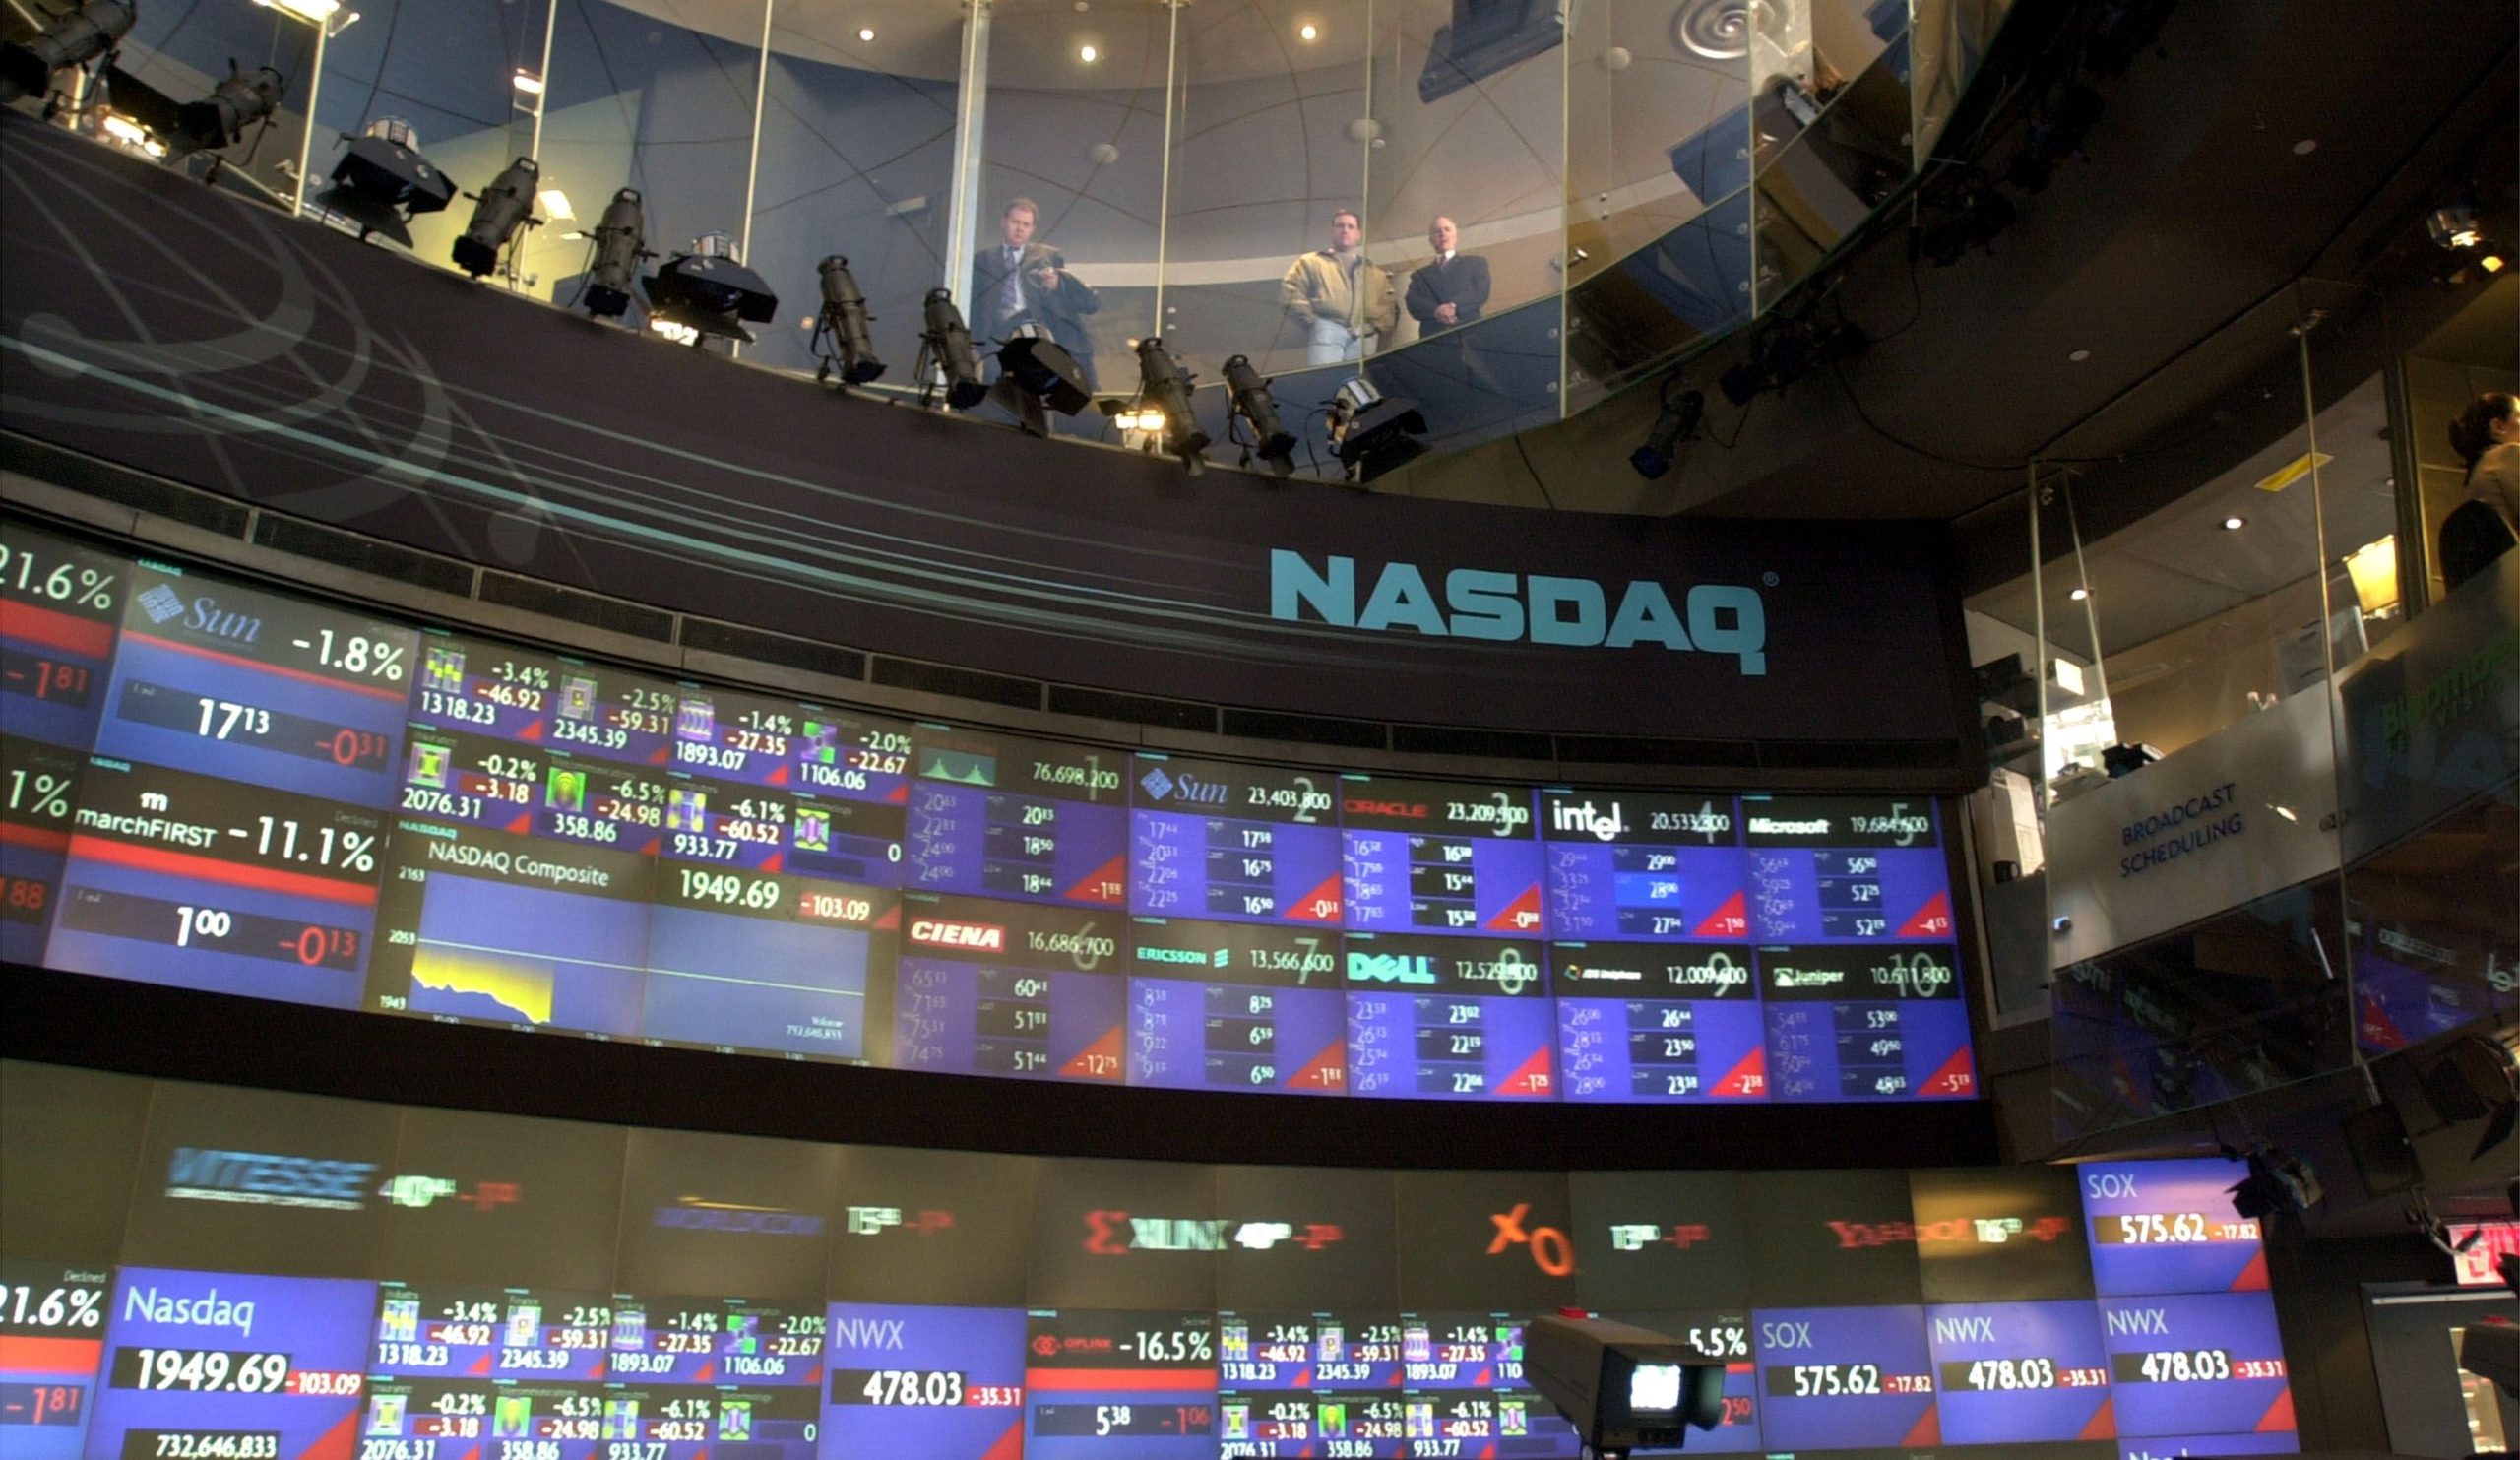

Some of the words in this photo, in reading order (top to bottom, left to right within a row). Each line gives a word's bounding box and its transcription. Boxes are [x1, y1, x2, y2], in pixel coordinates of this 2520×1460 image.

[1271, 548, 1767, 676] NASDAQ
[183, 596, 261, 643] Sun
[293, 629, 405, 680] -1.8%
[492, 662, 549, 689] -3.4%
[420, 691, 495, 725] 1318.23
[477, 684, 541, 712] -46.92
[622, 688, 676, 714] -2.5%
[609, 709, 670, 735] -59.31
[738, 711, 792, 735] -1.4%
[553, 719, 628, 750] 2345.39
[727, 731, 787, 757] -27.35
[859, 730, 912, 755] -2.0%
[675, 741, 745, 770] 1893.07
[849, 751, 907, 775] -22.67
[477, 754, 537, 782] -0.2%
[800, 762, 867, 791] 1106.06
[475, 778, 530, 804] -3.18
[610, 780, 665, 805] -6.5%
[1174, 772, 1228, 803] Sun
[140, 792, 169, 812] m
[401, 787, 482, 820] 2076.31
[730, 798, 786, 823] -6.1%
[1344, 799, 1427, 818] ORACLE
[598, 799, 662, 828] -24.98
[2122, 783, 2236, 846] BROADCAST
[554, 813, 617, 843] 358.86
[719, 821, 780, 845] -60.52
[1748, 817, 1831, 834] Microsoft
[75, 807, 218, 848] marchFIRST
[227, 815, 375, 872] -11.1%
[673, 834, 738, 860] 933.77
[2120, 813, 2243, 878] SCHEDULING
[428, 841, 511, 874] NASDAQ
[514, 855, 610, 887] Composite
[887, 843, 902, 863] 0
[680, 868, 780, 910] 1949.69
[801, 895, 870, 921] -103.09
[911, 921, 1001, 948] CIENA
[1137, 947, 1207, 965] ERICSSON
[1347, 952, 1435, 984] DELL
[1794, 969, 1844, 983] Juniper
[2088, 1174, 2137, 1199] SOX
[2120, 1213, 2208, 1244] 575.62
[2214, 1224, 2258, 1240] -17.82
[124, 1286, 255, 1337] Nasdaq
[443, 1301, 497, 1323] -3.4%
[563, 1307, 611, 1327] -2.5%
[668, 1312, 718, 1332] -1.4%
[2107, 1308, 2169, 1336] NWX
[431, 1324, 491, 1346] -46.92
[779, 1316, 826, 1335] -2.0%
[836, 1318, 905, 1350] NWX
[1267, 1325, 1309, 1343] -3.4%
[1361, 1326, 1402, 1343] -2.5%
[1447, 1326, 1488, 1343] -1.4%
[1762, 1322, 1813, 1349] SOX
[1935, 1317, 1996, 1344] NWX
[551, 1330, 608, 1349] -59.31
[658, 1334, 712, 1353] -27.35
[769, 1337, 822, 1356] -22.67
[1063, 1338, 1112, 1350] OPLINK
[1119, 1331, 1212, 1361] -16.5%
[379, 1344, 448, 1365] 1318.23
[500, 1349, 569, 1369] 2345.39
[611, 1353, 675, 1373] 1893.07
[1260, 1345, 1306, 1363] -46.92
[1354, 1345, 1399, 1362] -59.31
[1441, 1346, 1485, 1362] -27.35
[138, 1349, 287, 1393] 1949.69
[285, 1372, 361, 1395] -103.09
[724, 1357, 785, 1375] 1106.06
[1221, 1362, 1277, 1380] 1318.23
[1316, 1363, 1370, 1380] 2345.39
[1405, 1364, 1457, 1379] 1893.07
[1497, 1363, 1523, 1379] 110
[1968, 1359, 2054, 1391] 478.03
[2063, 1369, 2107, 1387] -35.31
[2141, 1350, 2230, 1382] 478.03
[2237, 1361, 2284, 1378] -35.31
[863, 1371, 962, 1406] 478.03
[972, 1387, 1021, 1406] -35.31
[1794, 1365, 1881, 1397] 575.62
[1888, 1376, 1932, 1393] -17.82
[431, 1394, 486, 1415] -0.2%
[553, 1398, 602, 1416] -6.5%
[661, 1400, 711, 1419] -6.1%
[1268, 1403, 1310, 1421] -0.2%
[1363, 1402, 1404, 1420] -6.5%
[1450, 1401, 1491, 1418] -6.1%
[429, 1417, 479, 1437] -3.18
[541, 1420, 600, 1440] -24.98
[650, 1422, 705, 1440] -60.52
[804, 1424, 816, 1442] 0
[1269, 1422, 1307, 1440] -3.18
[1356, 1422, 1402, 1438] -24.98
[1444, 1420, 1489, 1437] -60.52
[157, 1435, 277, 1458] 732,646,833
[362, 1440, 435, 1460] 2076.31
[502, 1441, 560, 1460] 358.86
[609, 1443, 667, 1460] 933.77
[1327, 1440, 1373, 1458] 358.86
[1414, 1439, 1461, 1457] 933.77
